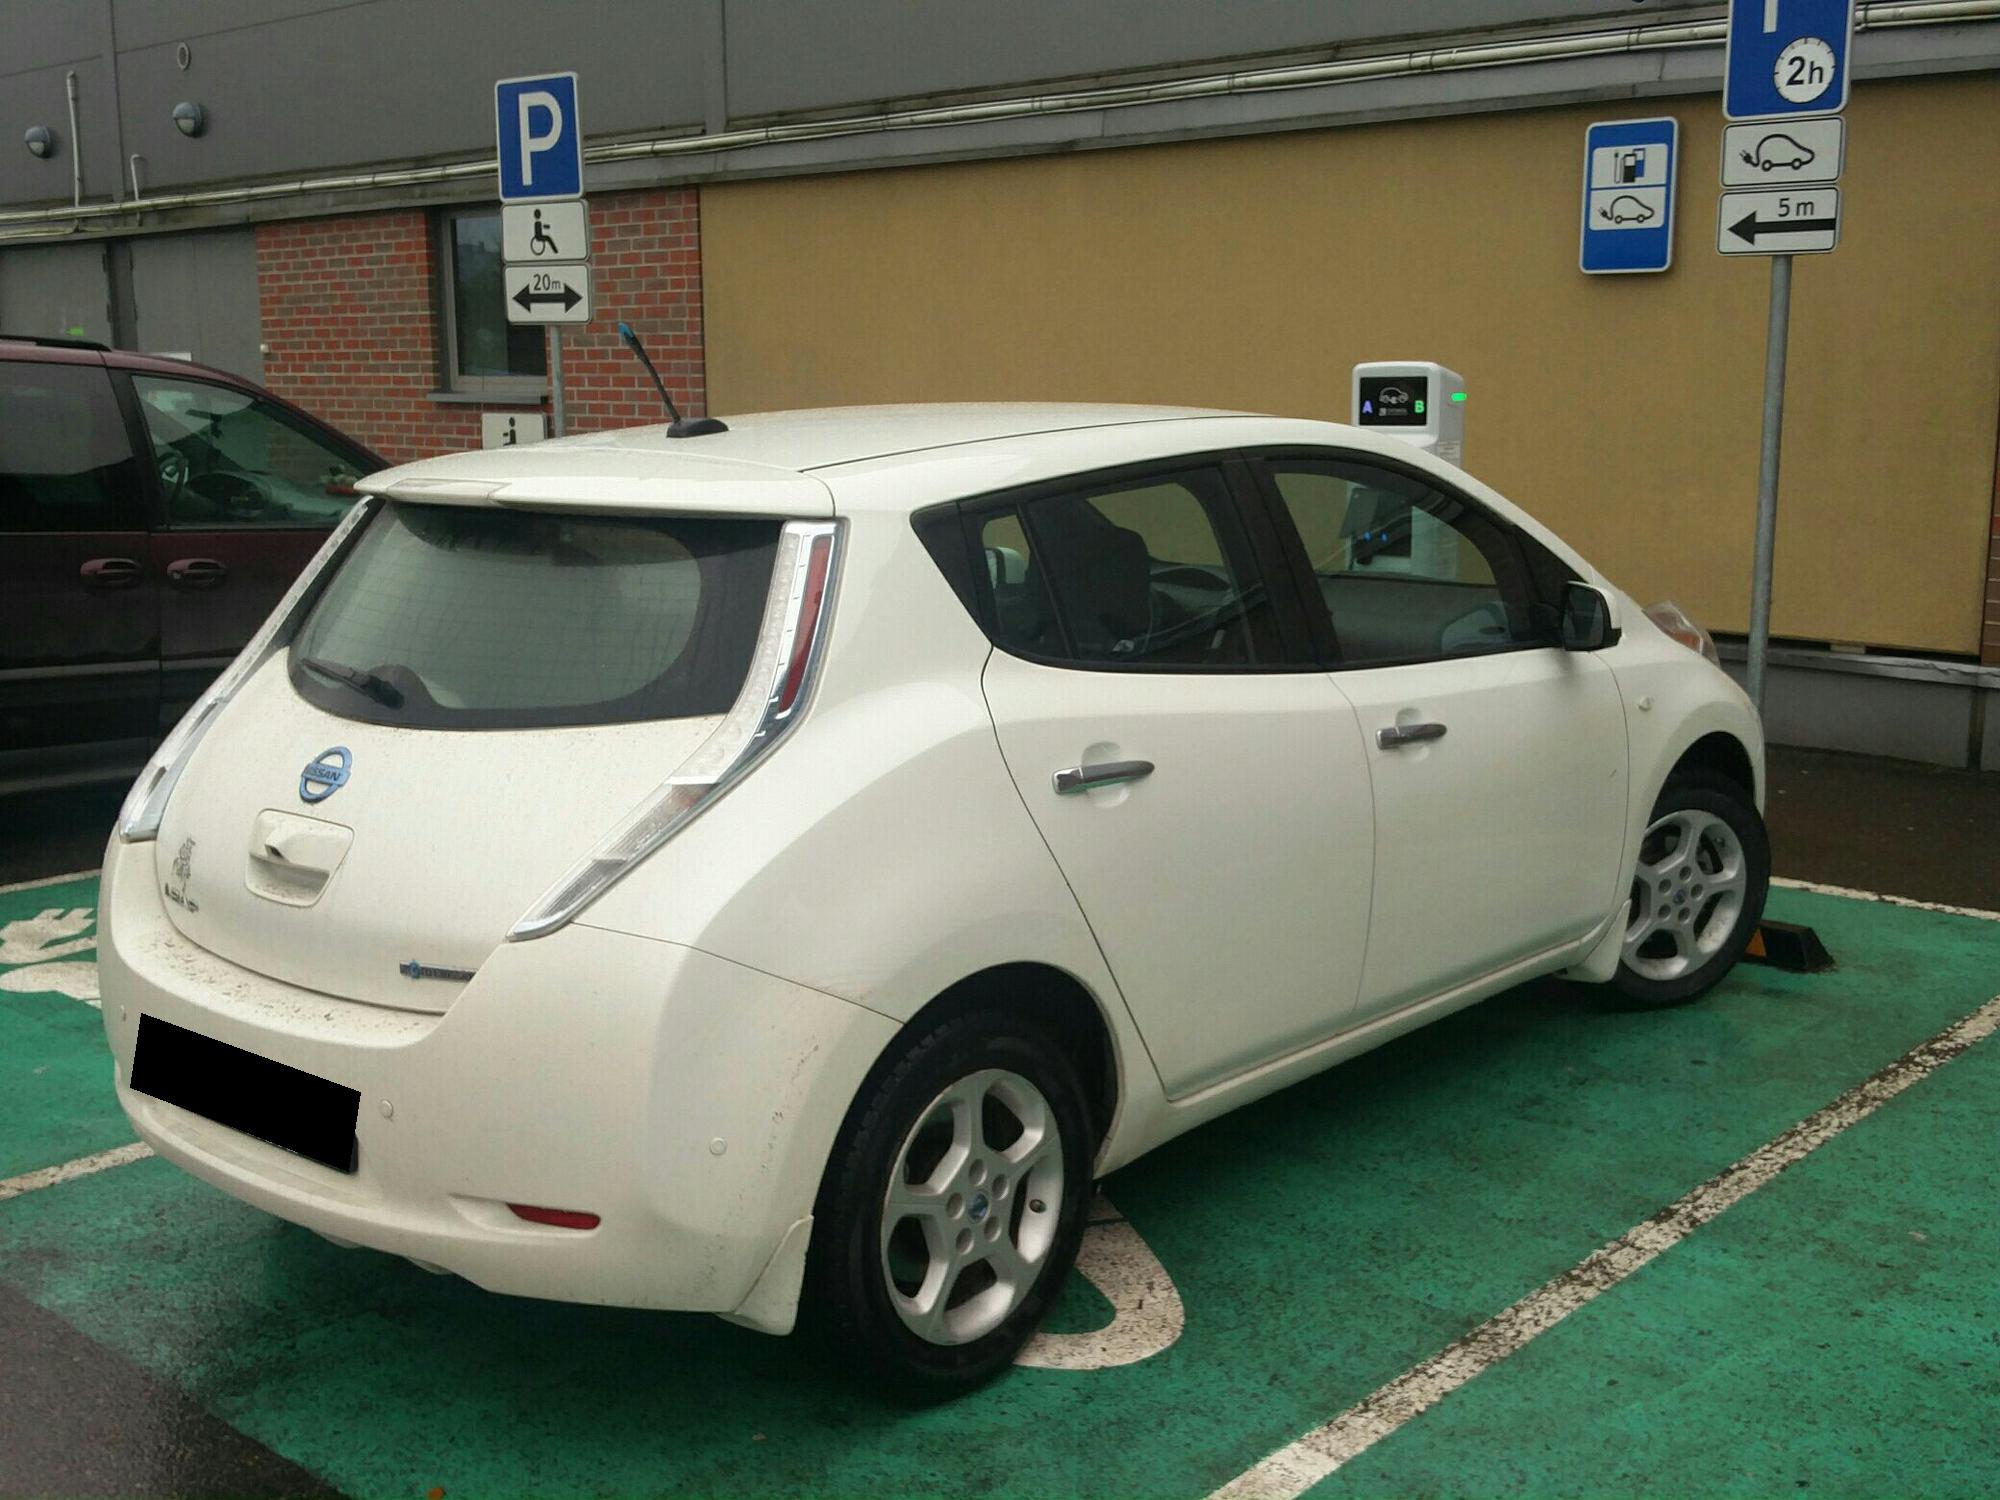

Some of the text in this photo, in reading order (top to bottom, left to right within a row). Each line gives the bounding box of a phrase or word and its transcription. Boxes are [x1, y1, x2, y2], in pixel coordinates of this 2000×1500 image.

[1786, 56, 1824, 86] 2h
[518, 91, 563, 186] P
[1778, 197, 1815, 217] 5 m
[1362, 400, 1373, 414] A
[1414, 400, 1425, 413] B
